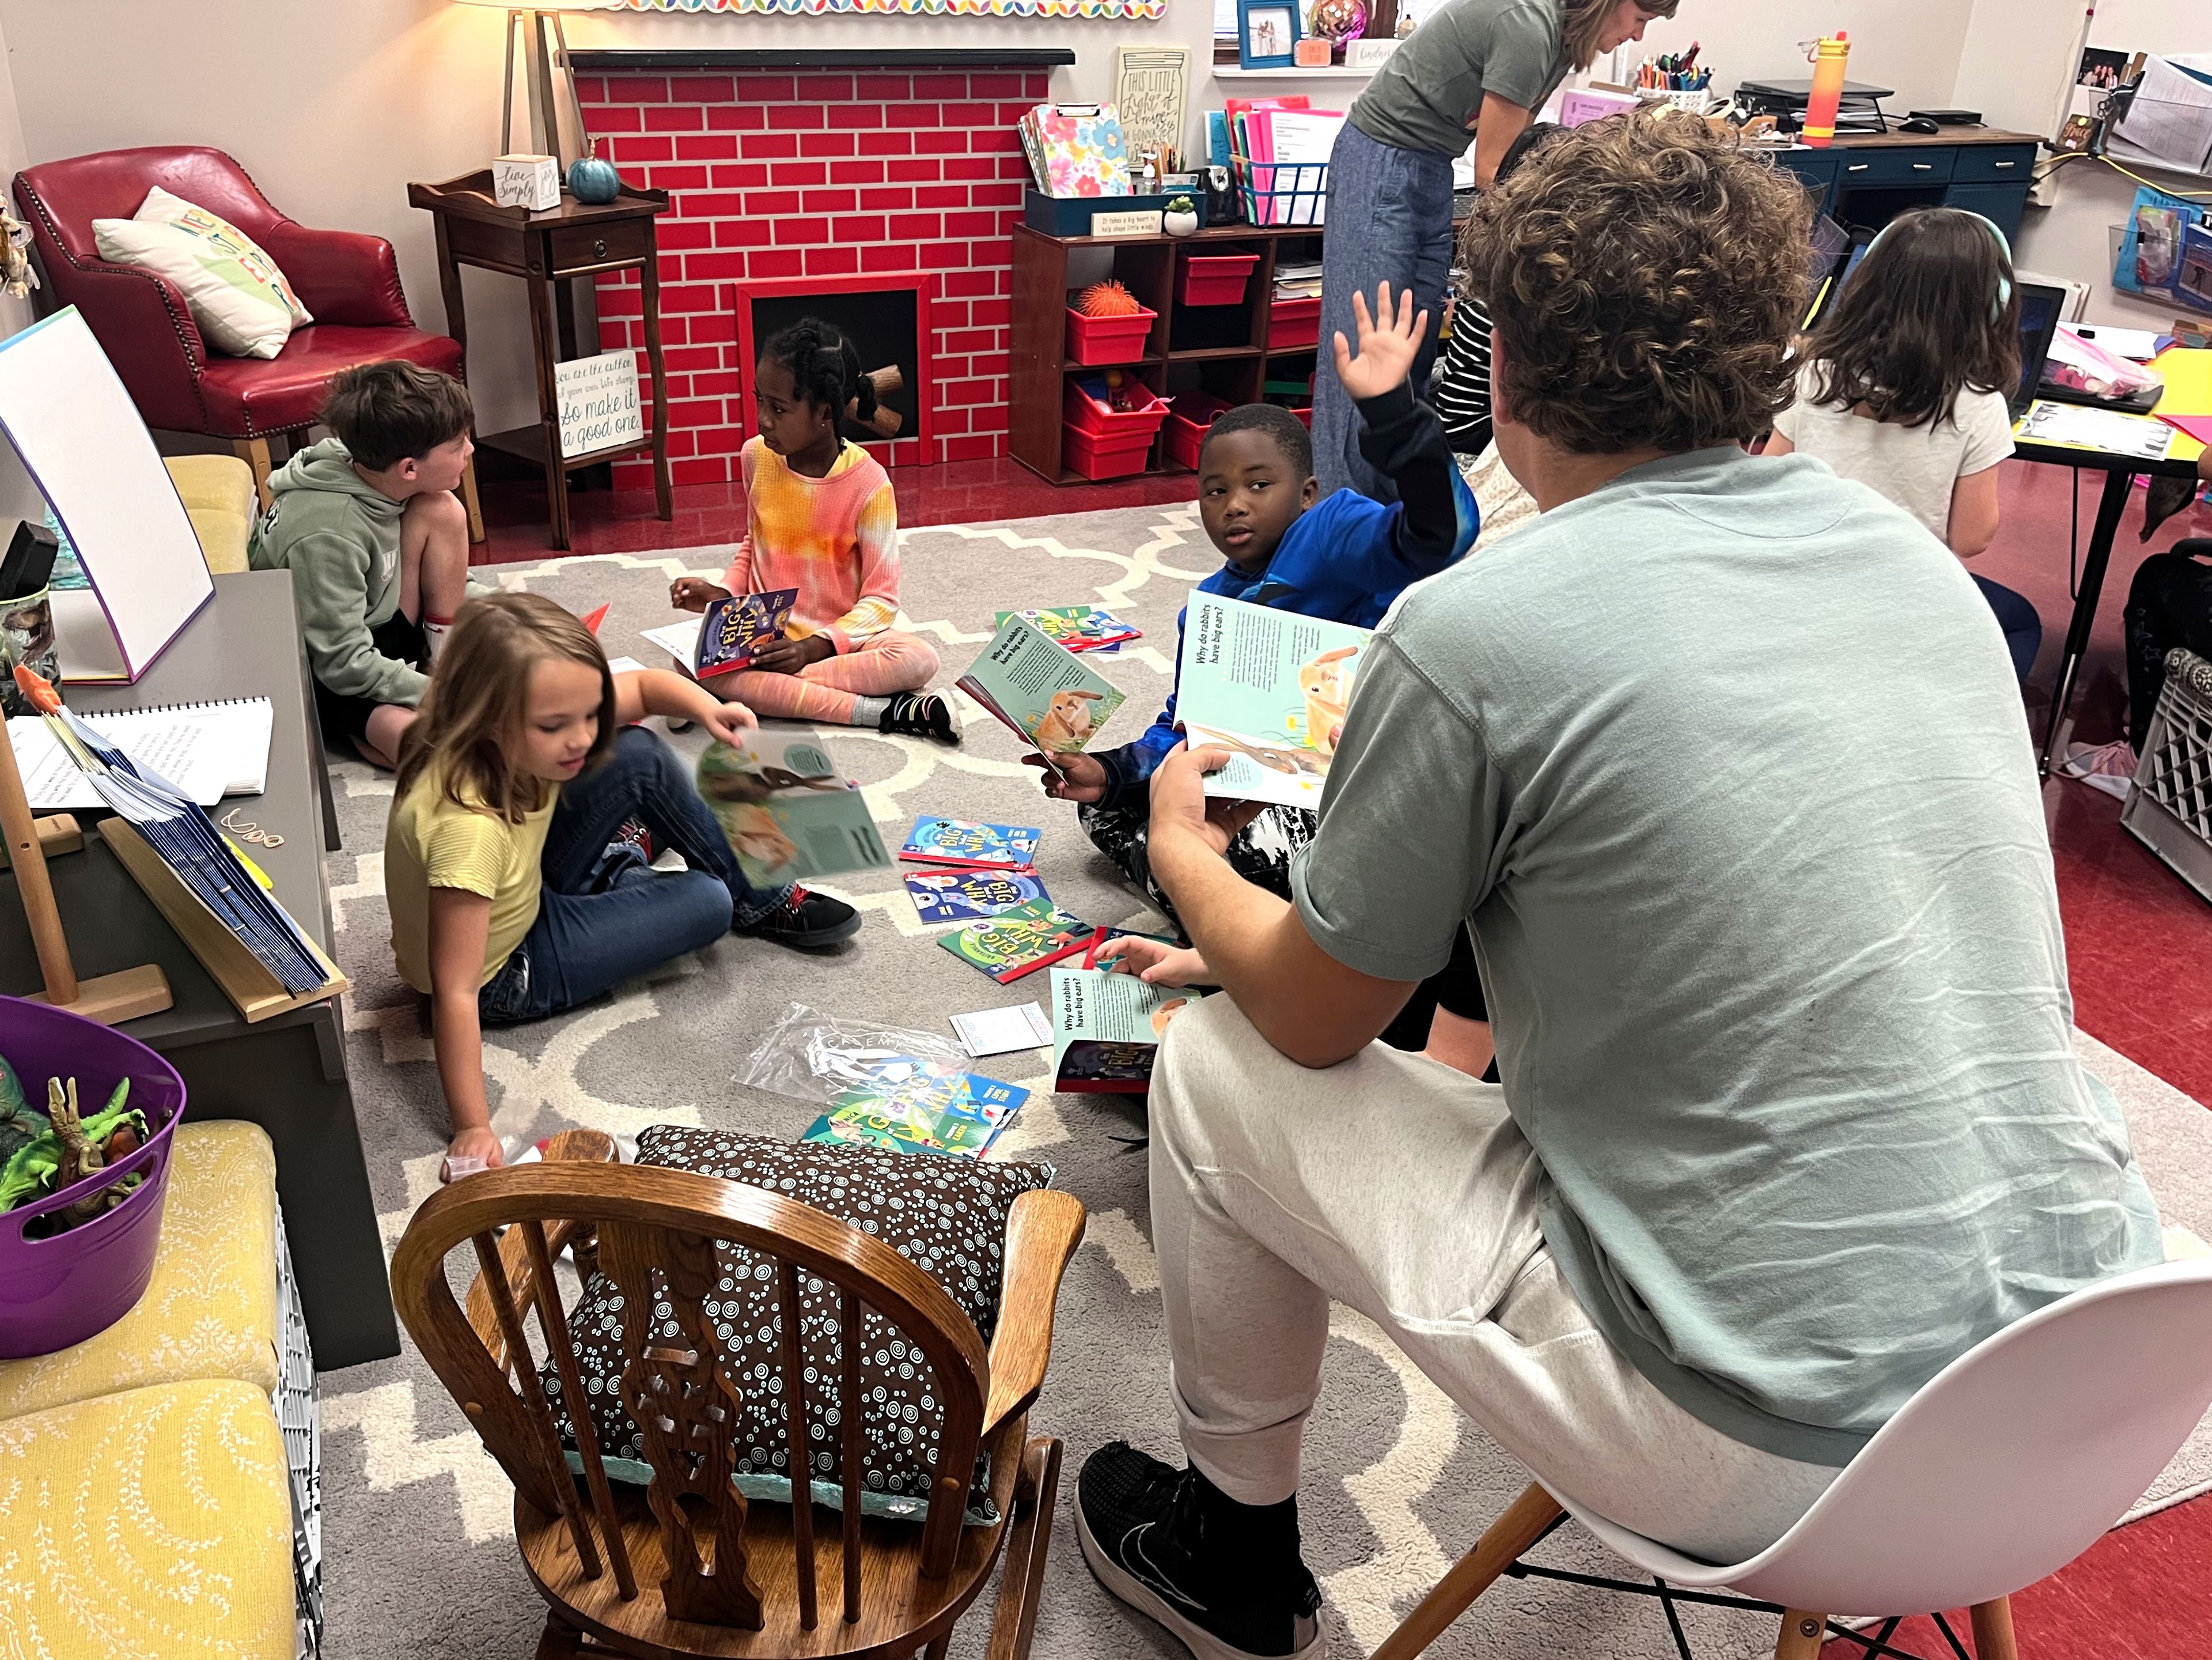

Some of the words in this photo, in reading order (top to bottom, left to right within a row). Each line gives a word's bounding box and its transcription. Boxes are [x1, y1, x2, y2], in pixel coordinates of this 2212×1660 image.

[1128, 70, 1147, 92] THIS
[1149, 69, 1177, 92] LITTLE
[1132, 129, 1156, 141] GONNA
[585, 393, 622, 419] make
[625, 387, 637, 410] it
[563, 431, 575, 447] a
[577, 417, 612, 451] good
[740, 607, 758, 647] WHY
[1200, 604, 1210, 633] rabbits
[1214, 607, 1224, 628] ears?
[723, 614, 741, 645] BIG
[1198, 635, 1207, 645] do
[1211, 629, 1224, 645] big
[990, 649, 1004, 661] Why
[1006, 626, 1023, 644] rabbits
[999, 652, 1013, 665] have
[1011, 644, 1021, 653] big
[1017, 630, 1030, 645] ears?
[1209, 644, 1220, 664] have
[1196, 646, 1209, 664] Why
[940, 829, 963, 847] BIG
[964, 829, 986, 853] WHY
[960, 880, 988, 907] WHY
[988, 881, 1015, 903] BIG
[981, 933, 1020, 955] BIG
[999, 923, 1044, 950] WHY
[1062, 977, 1071, 1002] rabbits
[1073, 977, 1082, 996] ears?
[1064, 1003, 1071, 1015] do
[1075, 997, 1084, 1009] big
[1065, 1014, 1074, 1031] Why
[1075, 1013, 1084, 1028] have
[952, 1125, 968, 1141] EARTH
